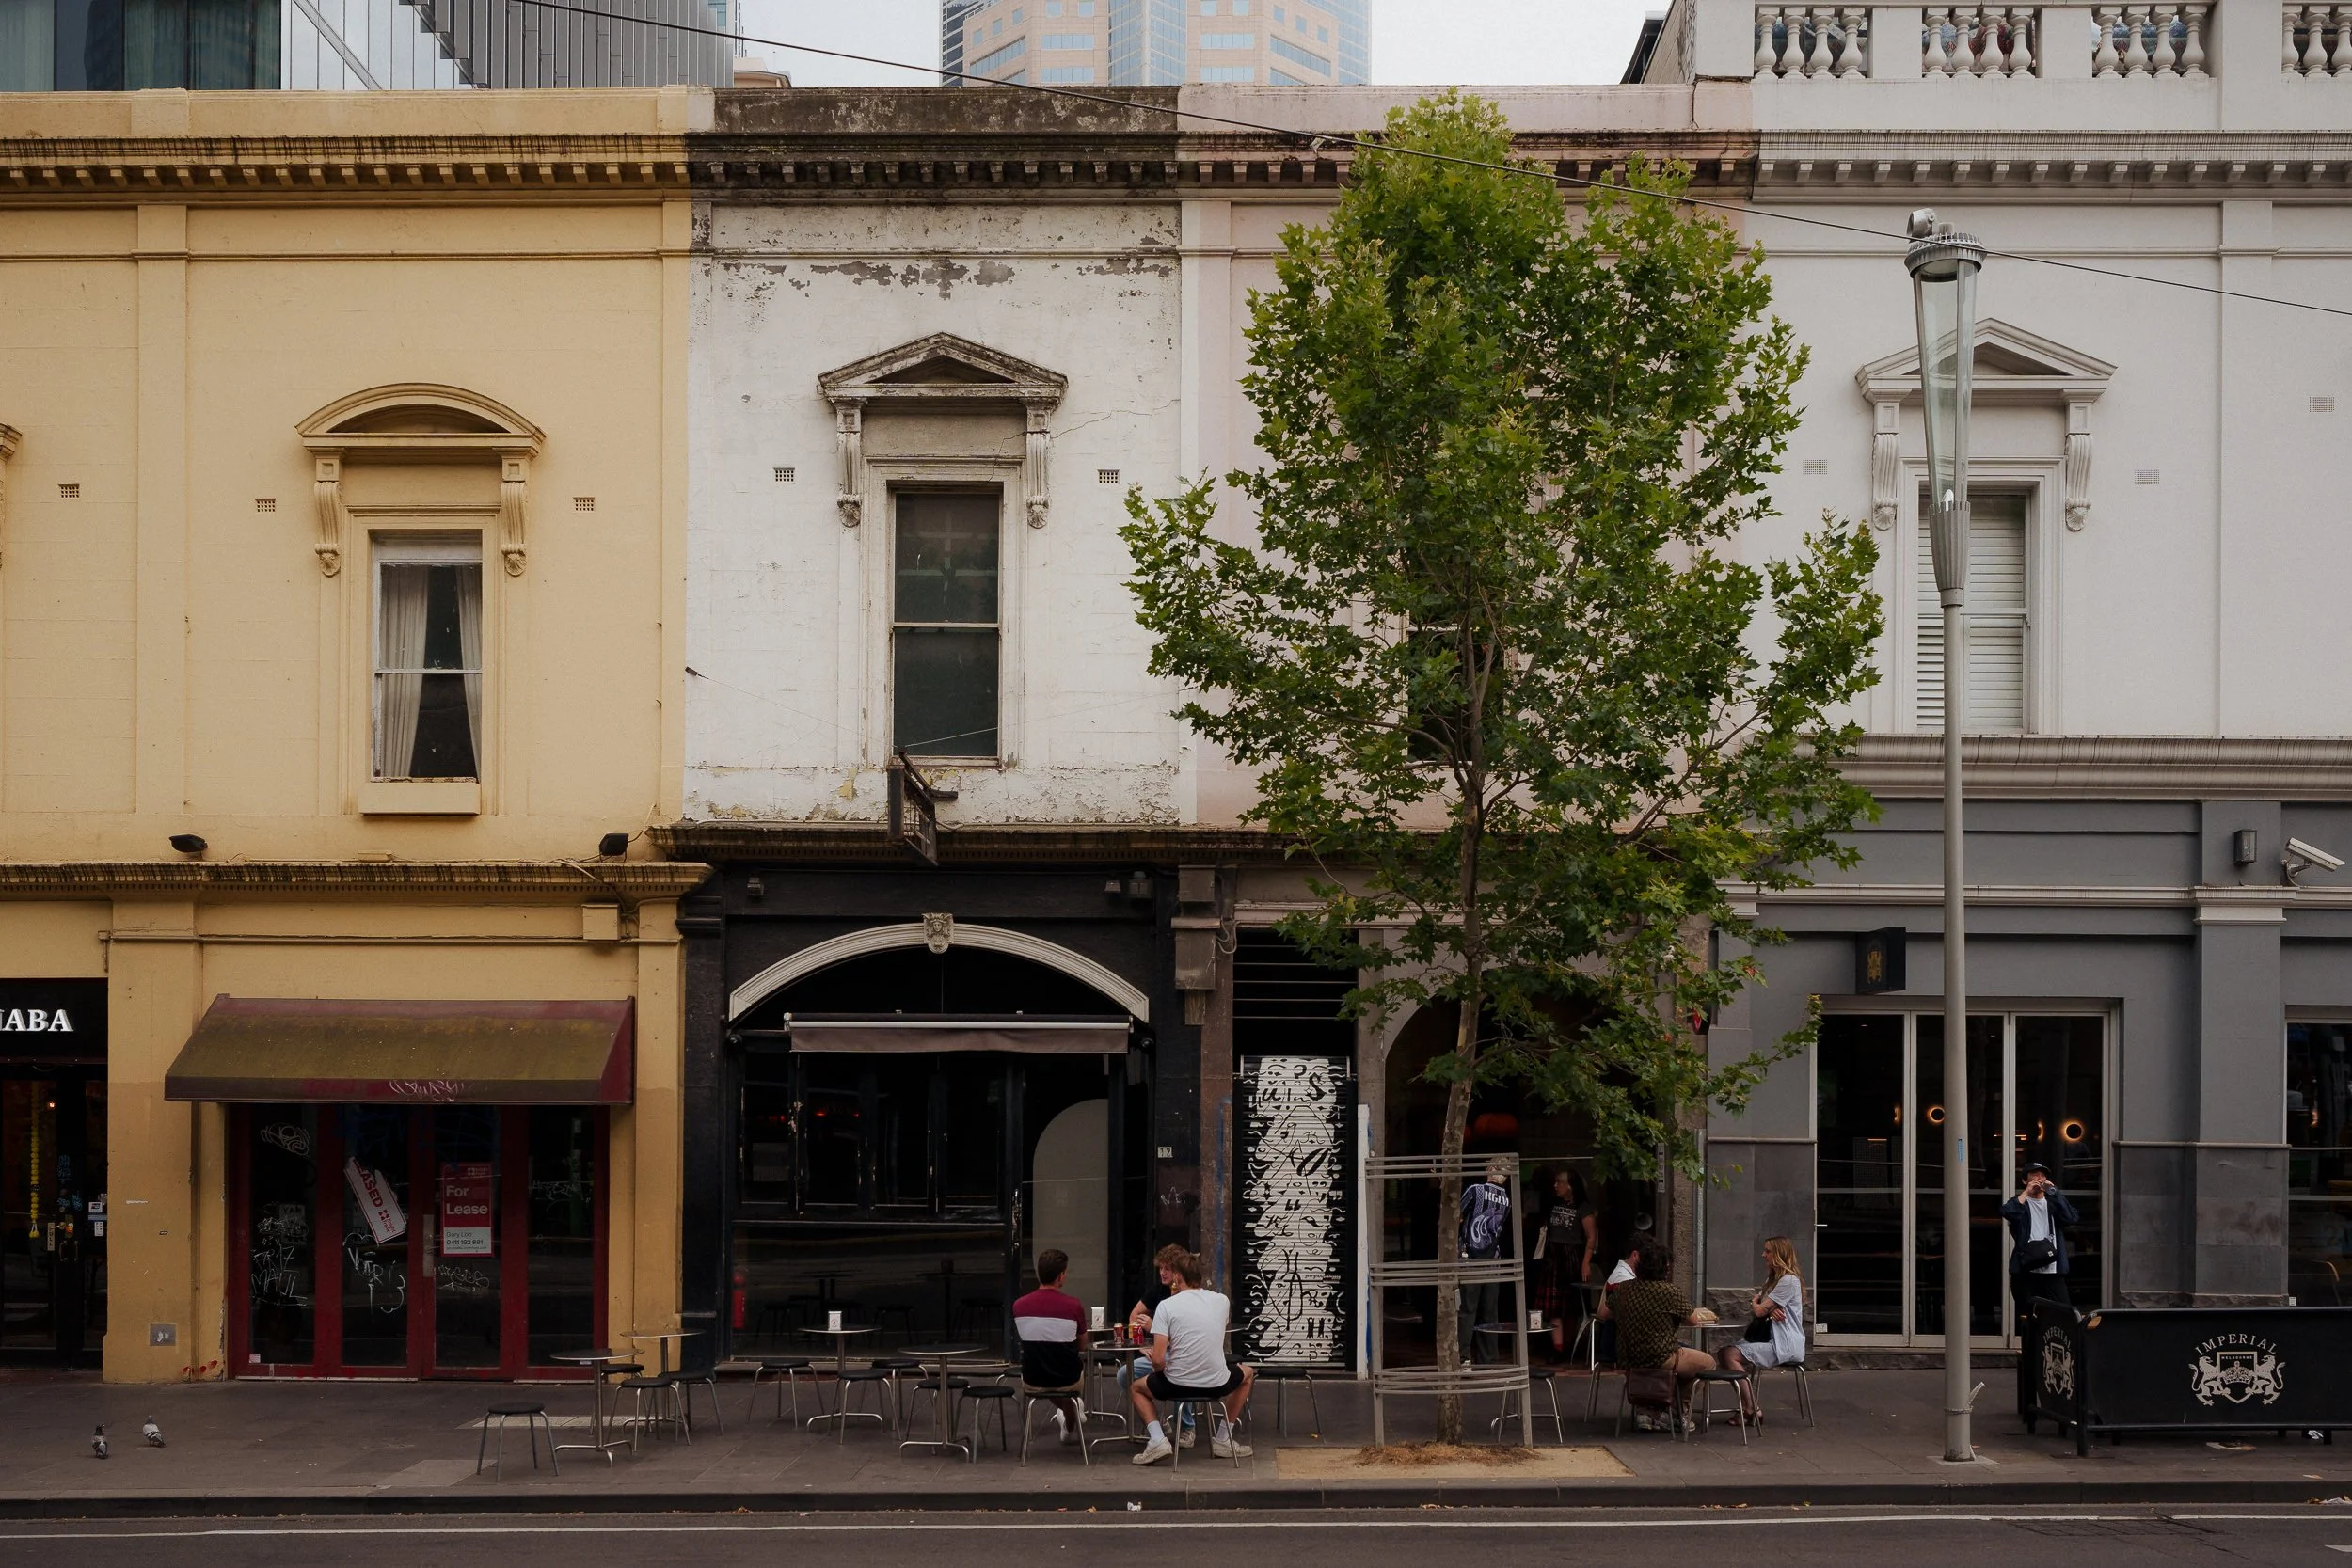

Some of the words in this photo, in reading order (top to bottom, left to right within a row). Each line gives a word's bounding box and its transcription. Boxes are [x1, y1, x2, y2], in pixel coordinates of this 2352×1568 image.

[446, 1185, 469, 1197] For
[446, 1203, 488, 1215] Lease
[2194, 1333, 2278, 1356] IMPERIAL
